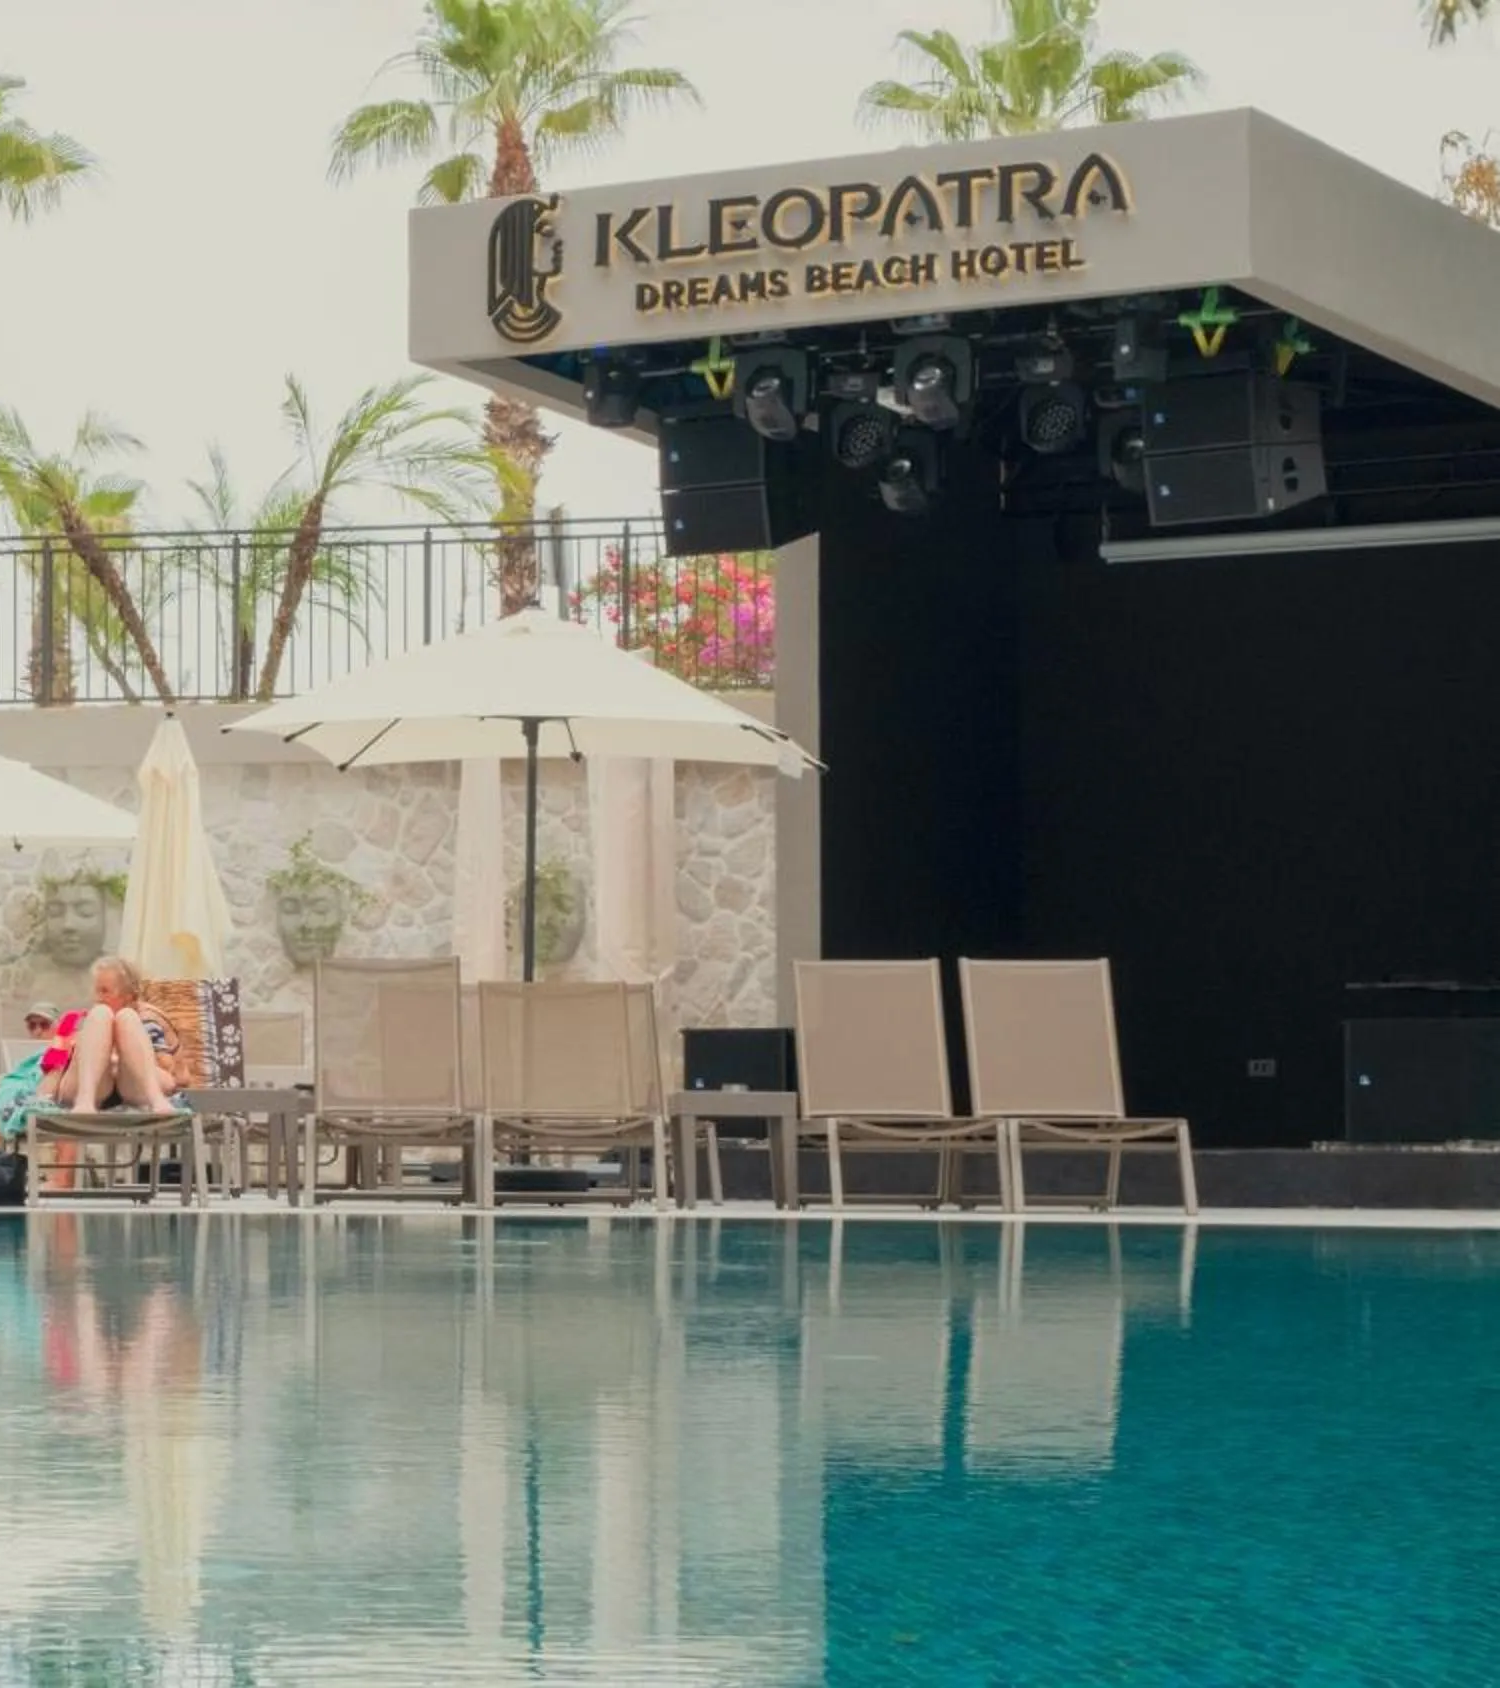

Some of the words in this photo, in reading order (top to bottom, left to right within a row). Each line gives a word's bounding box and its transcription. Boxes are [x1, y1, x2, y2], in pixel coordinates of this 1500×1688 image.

[594, 152, 1130, 267] KLEOPATRA
[635, 269, 790, 312] DREAMS
[804, 253, 938, 293] BEACH
[951, 239, 1086, 281] HOTEL
